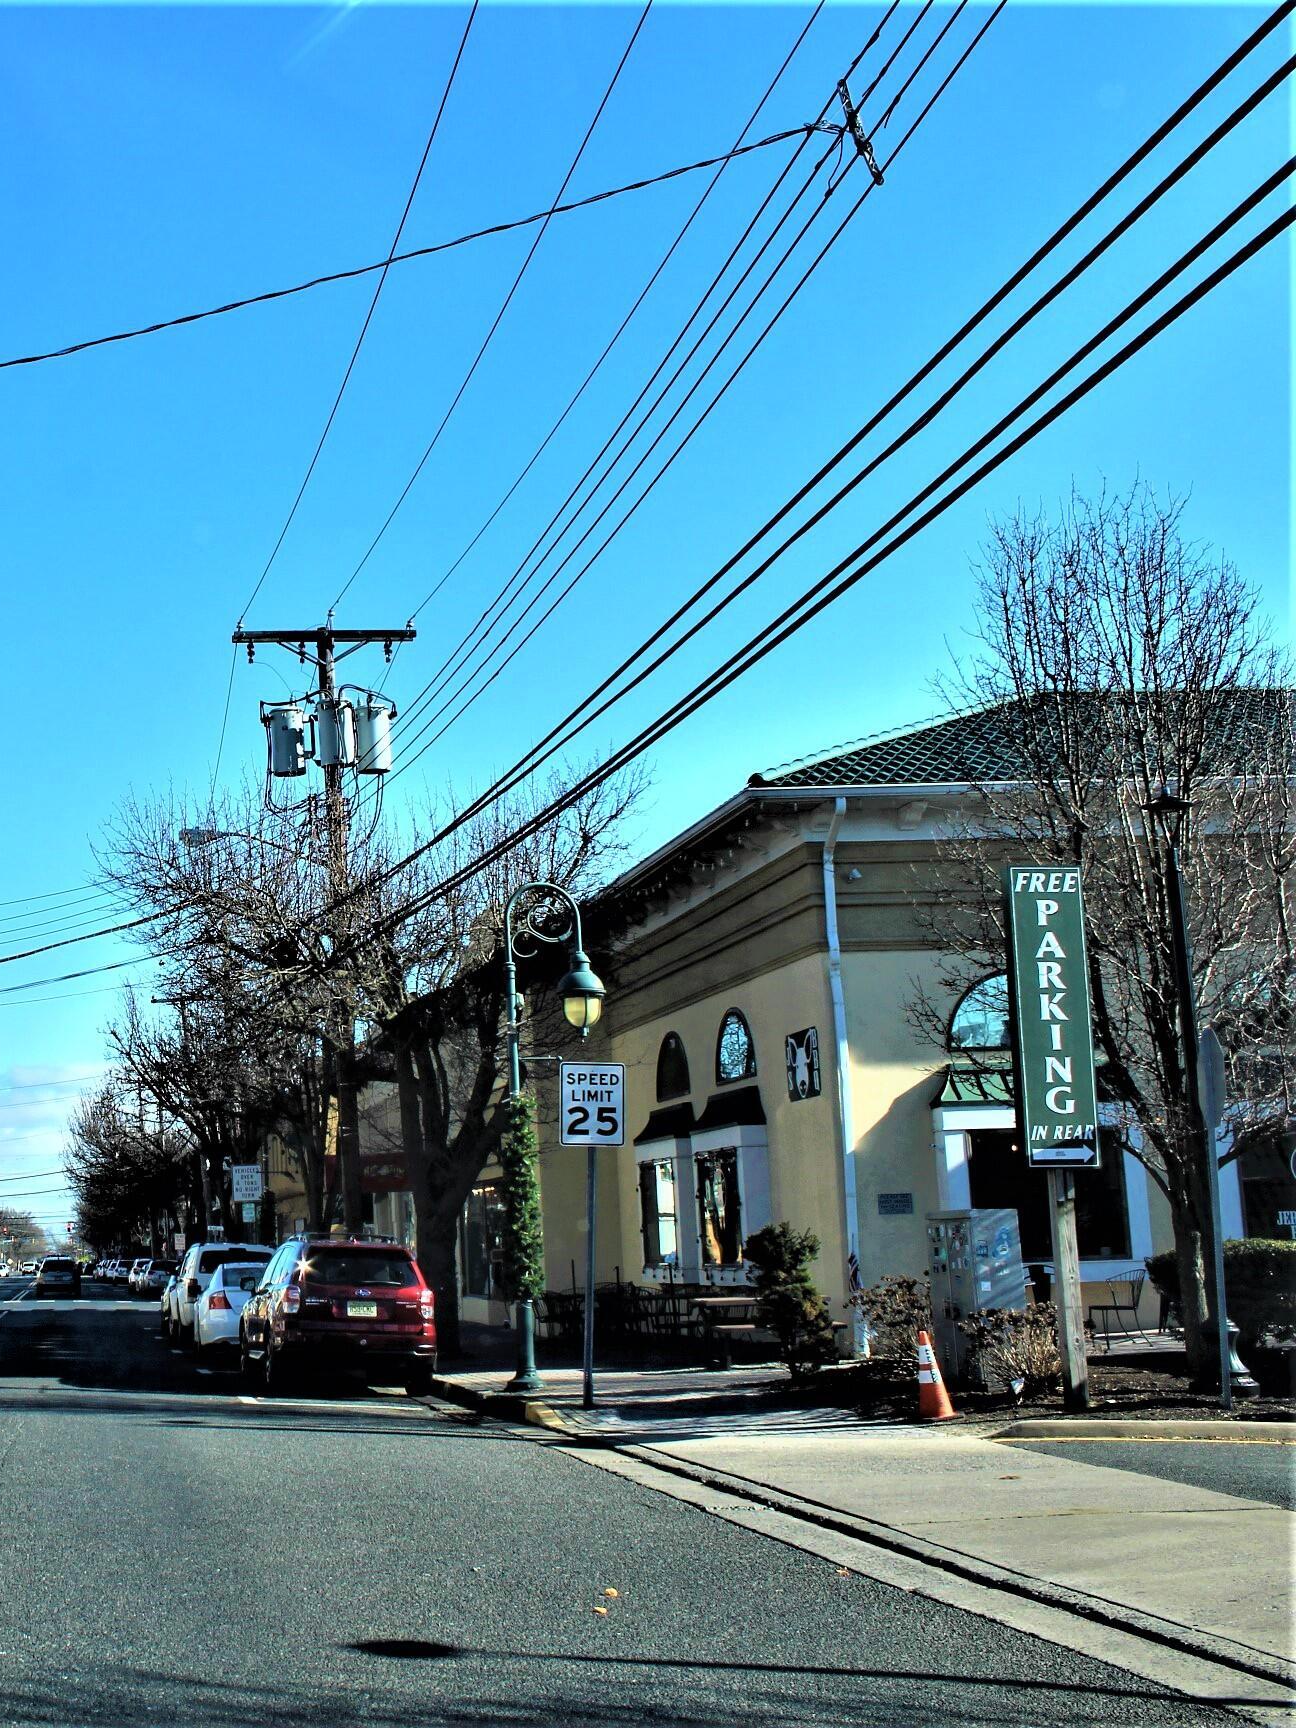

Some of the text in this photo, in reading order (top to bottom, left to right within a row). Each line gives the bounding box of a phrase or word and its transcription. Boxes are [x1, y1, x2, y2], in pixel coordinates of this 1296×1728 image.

[1014, 872, 1078, 893] FREE
[1034, 899, 1075, 1115] PARKING
[566, 1072, 620, 1086] SPEED
[571, 1089, 614, 1102] LIMIT
[566, 1106, 619, 1136] 25
[1030, 1124, 1095, 1141] IN REAR
